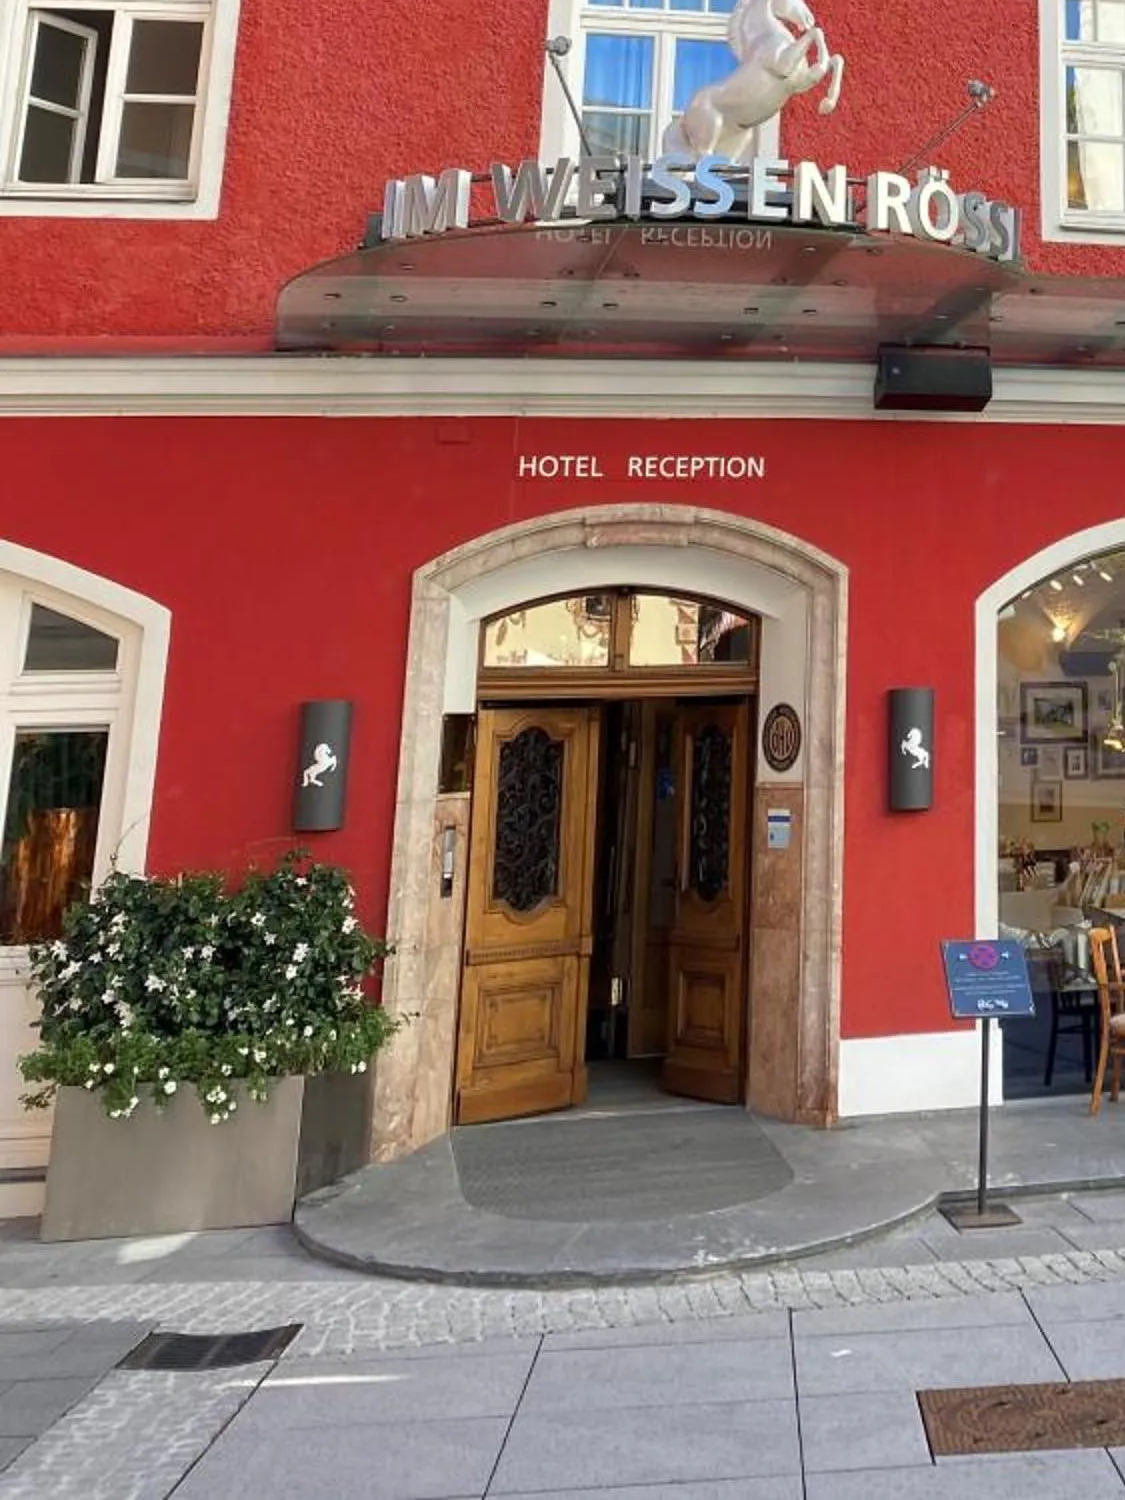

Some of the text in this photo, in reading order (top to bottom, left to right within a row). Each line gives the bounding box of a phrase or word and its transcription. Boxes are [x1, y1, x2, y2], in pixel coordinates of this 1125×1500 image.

[382, 168, 472, 239] IM
[490, 153, 847, 224] WEISSEN
[519, 455, 765, 478] HOTEL RECEPTION
